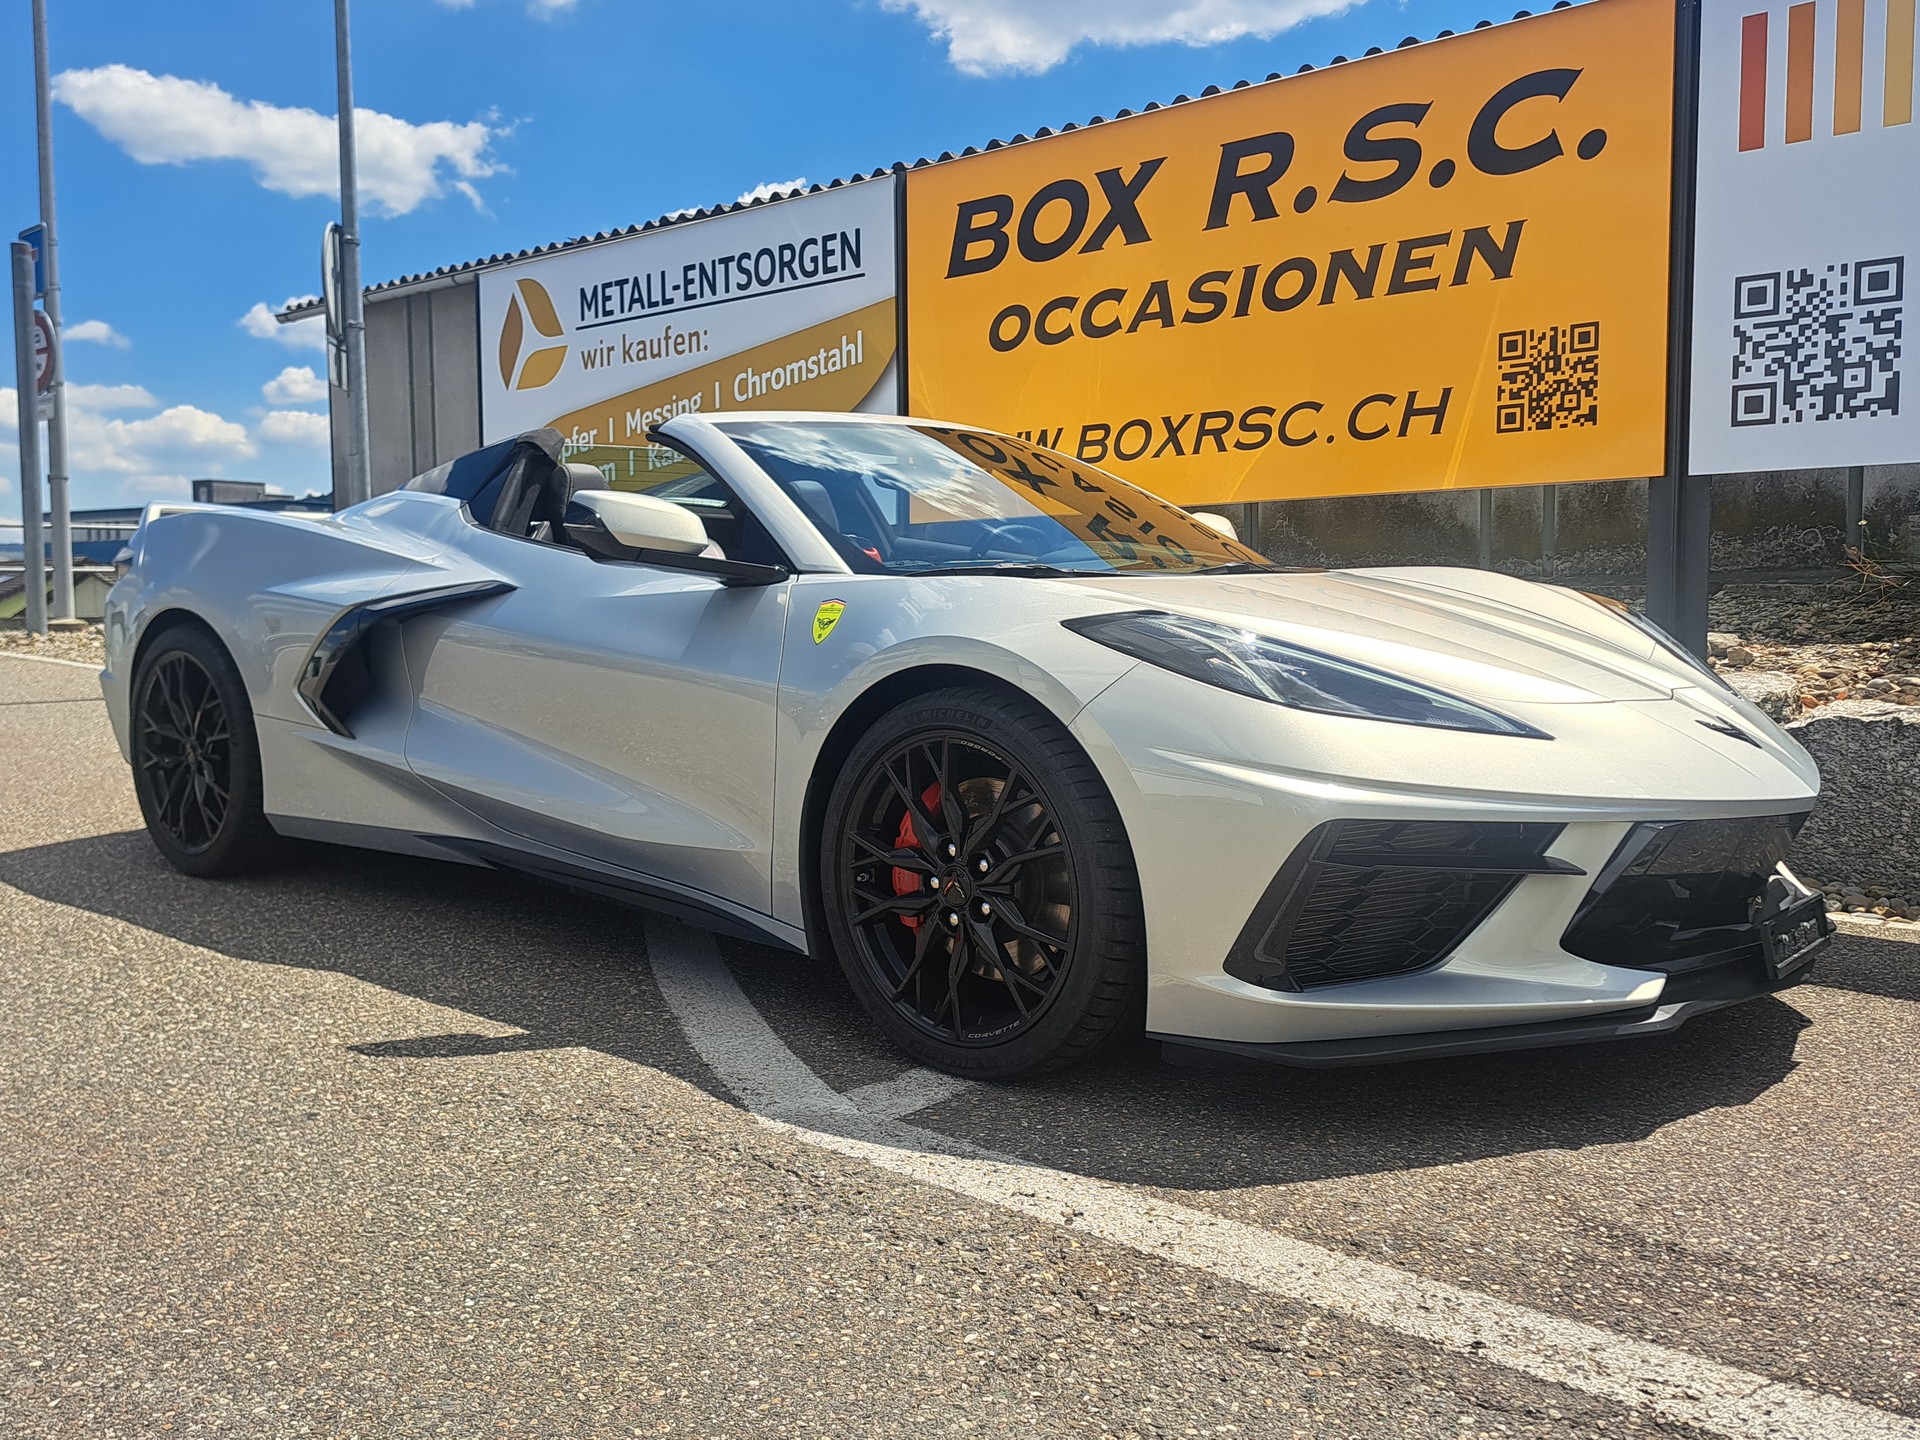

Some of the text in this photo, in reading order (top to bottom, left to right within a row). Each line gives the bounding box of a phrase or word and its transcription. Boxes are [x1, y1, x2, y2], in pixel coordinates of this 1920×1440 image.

[945, 68, 1608, 279] BOX R.S.C.
[580, 228, 862, 322] METALL-ENTSORGEN
[988, 218, 1528, 352] OCCASIONEN
[581, 325, 709, 370] wir kaufen:
[557, 329, 863, 465] pfer Messing Chromstahl
[921, 708, 989, 730] MICHELIN
[967, 1020, 1020, 1039] CORVETTE
